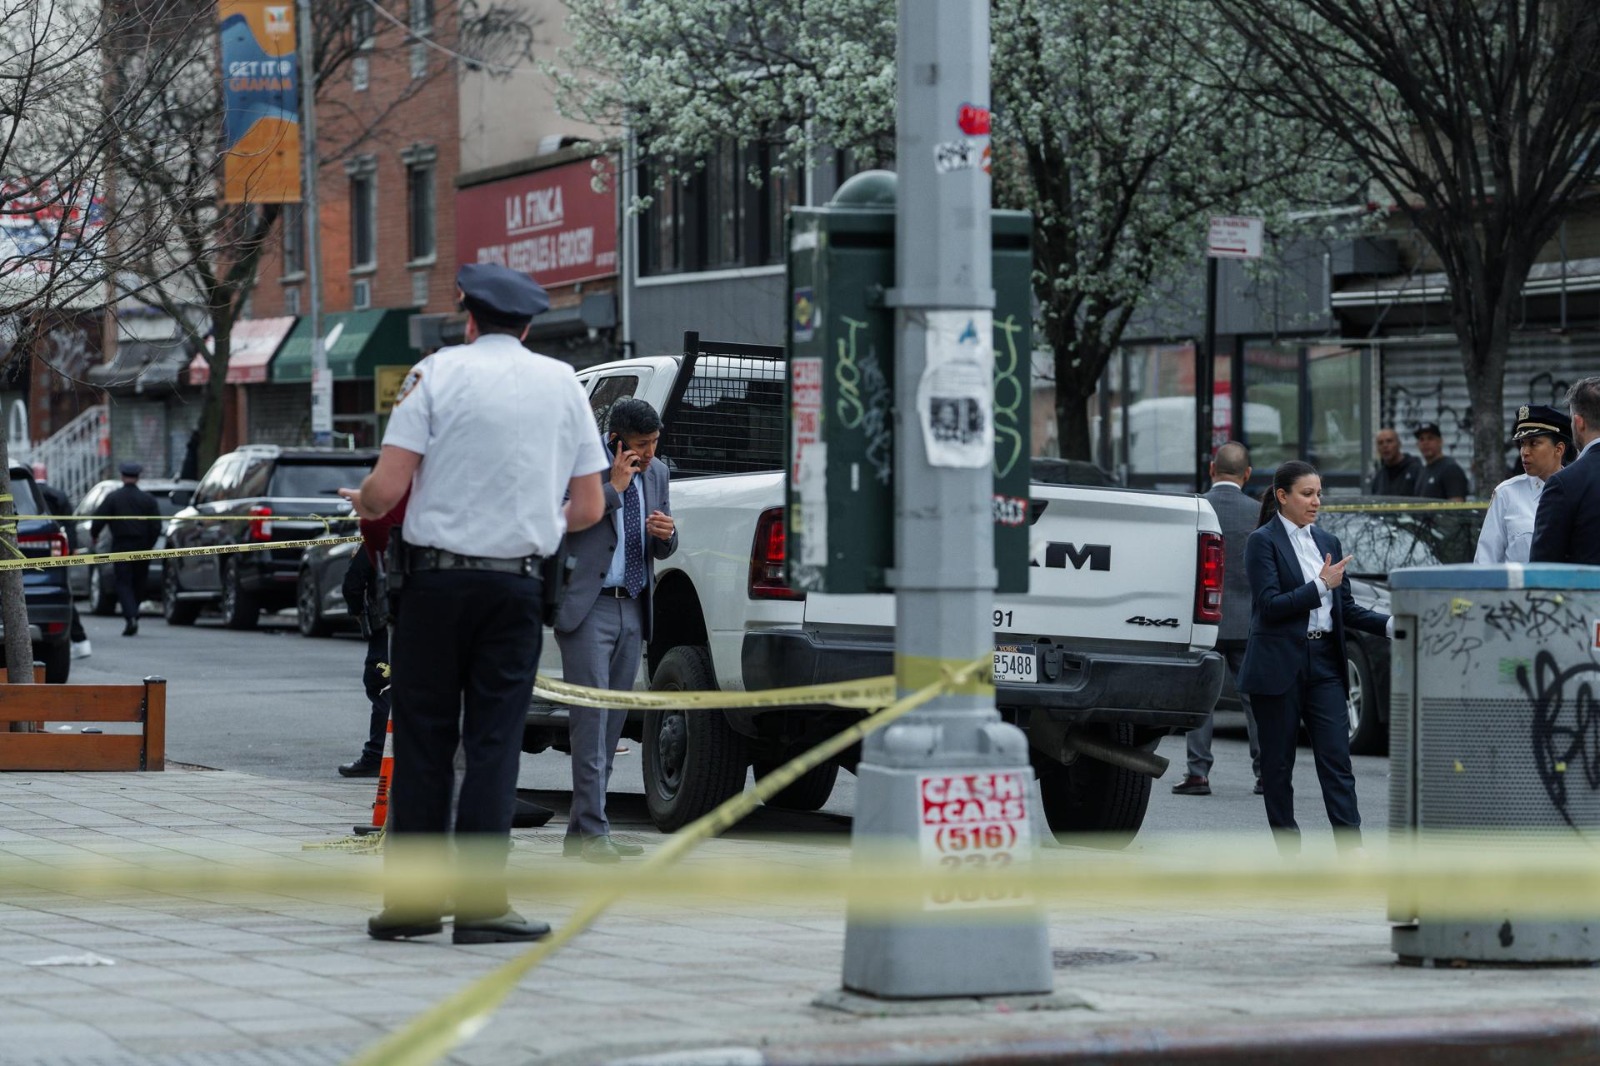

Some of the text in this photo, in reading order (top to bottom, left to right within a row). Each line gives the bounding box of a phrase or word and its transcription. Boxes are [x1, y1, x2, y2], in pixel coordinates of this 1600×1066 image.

[229, 61, 258, 76] GET
[261, 61, 277, 76] IT
[506, 186, 564, 230] LA FINCA
[1126, 615, 1181, 628] 4x4
[923, 775, 1022, 802] CASH
[935, 823, 1017, 852] (516)
